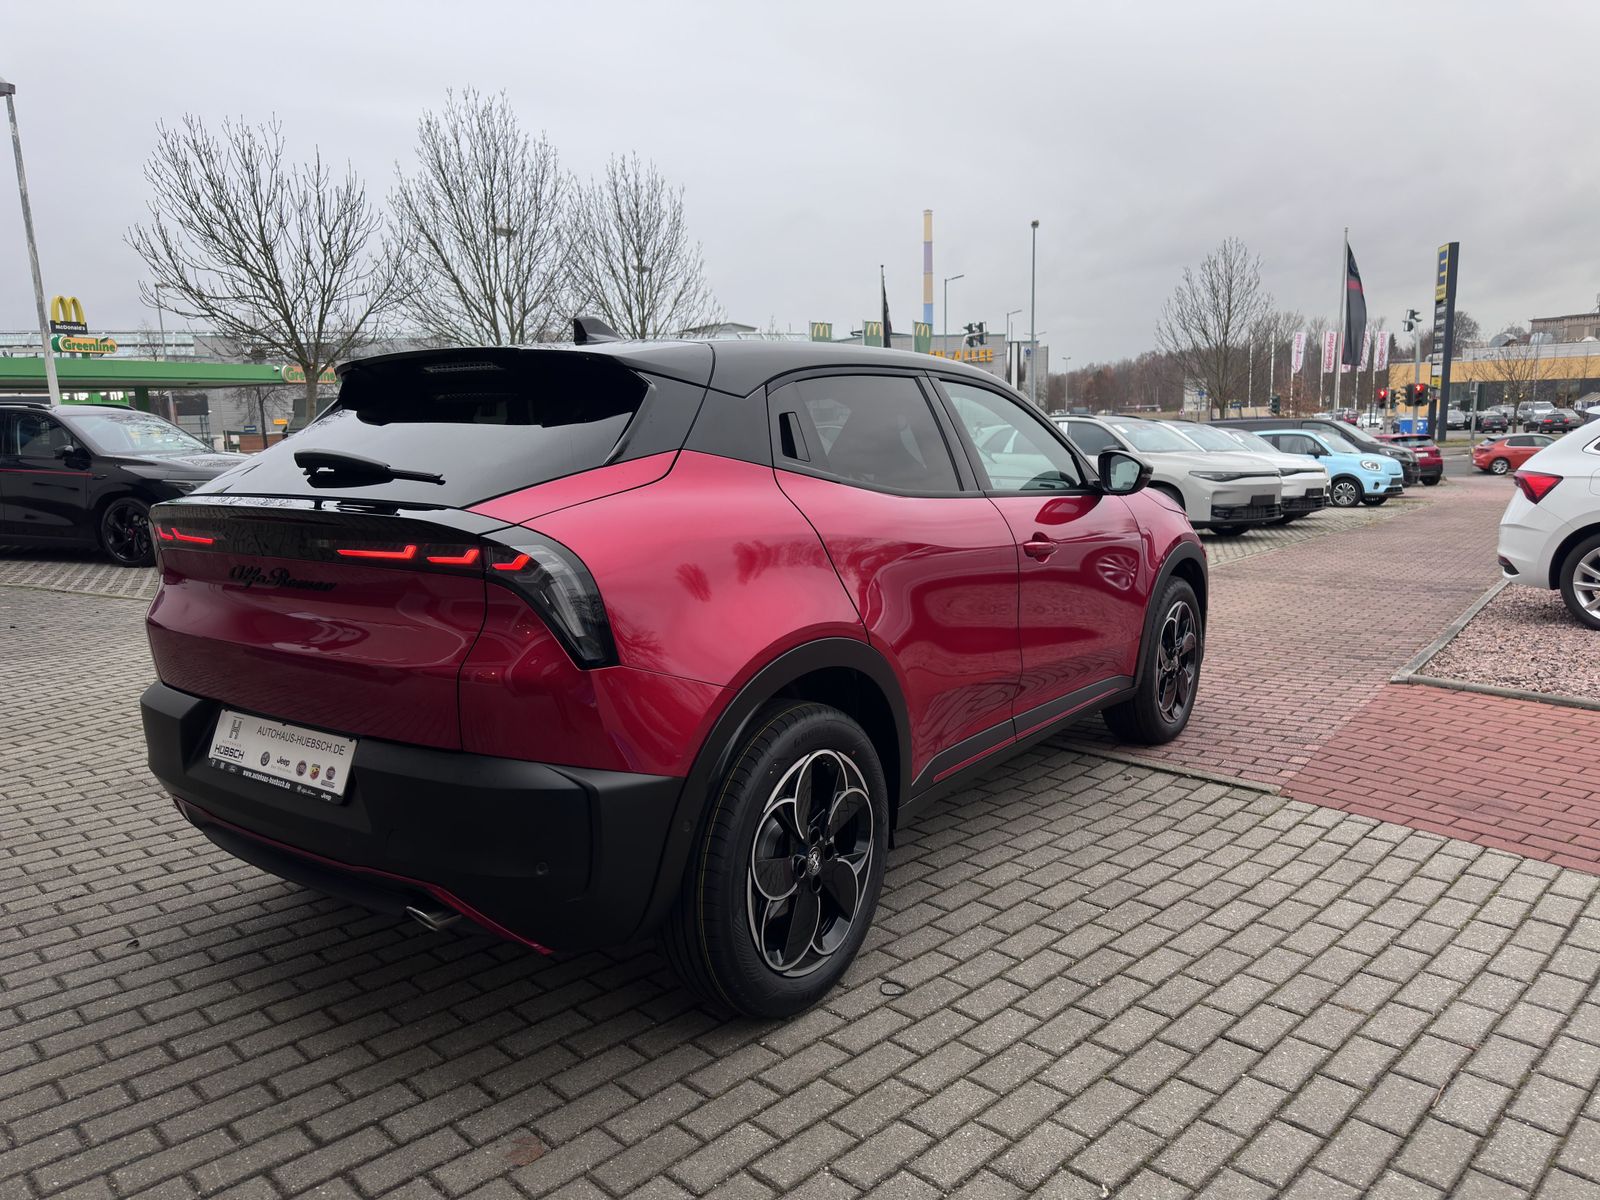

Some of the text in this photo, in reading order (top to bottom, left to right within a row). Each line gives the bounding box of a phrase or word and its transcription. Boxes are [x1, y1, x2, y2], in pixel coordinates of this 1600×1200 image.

[55, 324, 86, 332] McDonald's
[61, 338, 117, 353] Greenline
[285, 366, 336, 381] Greine
[228, 565, 337, 593] Alfa Romeo
[256, 726, 347, 756] AUTOHAUS-HUEBSCH.DE
[276, 756, 291, 768] Jeep
